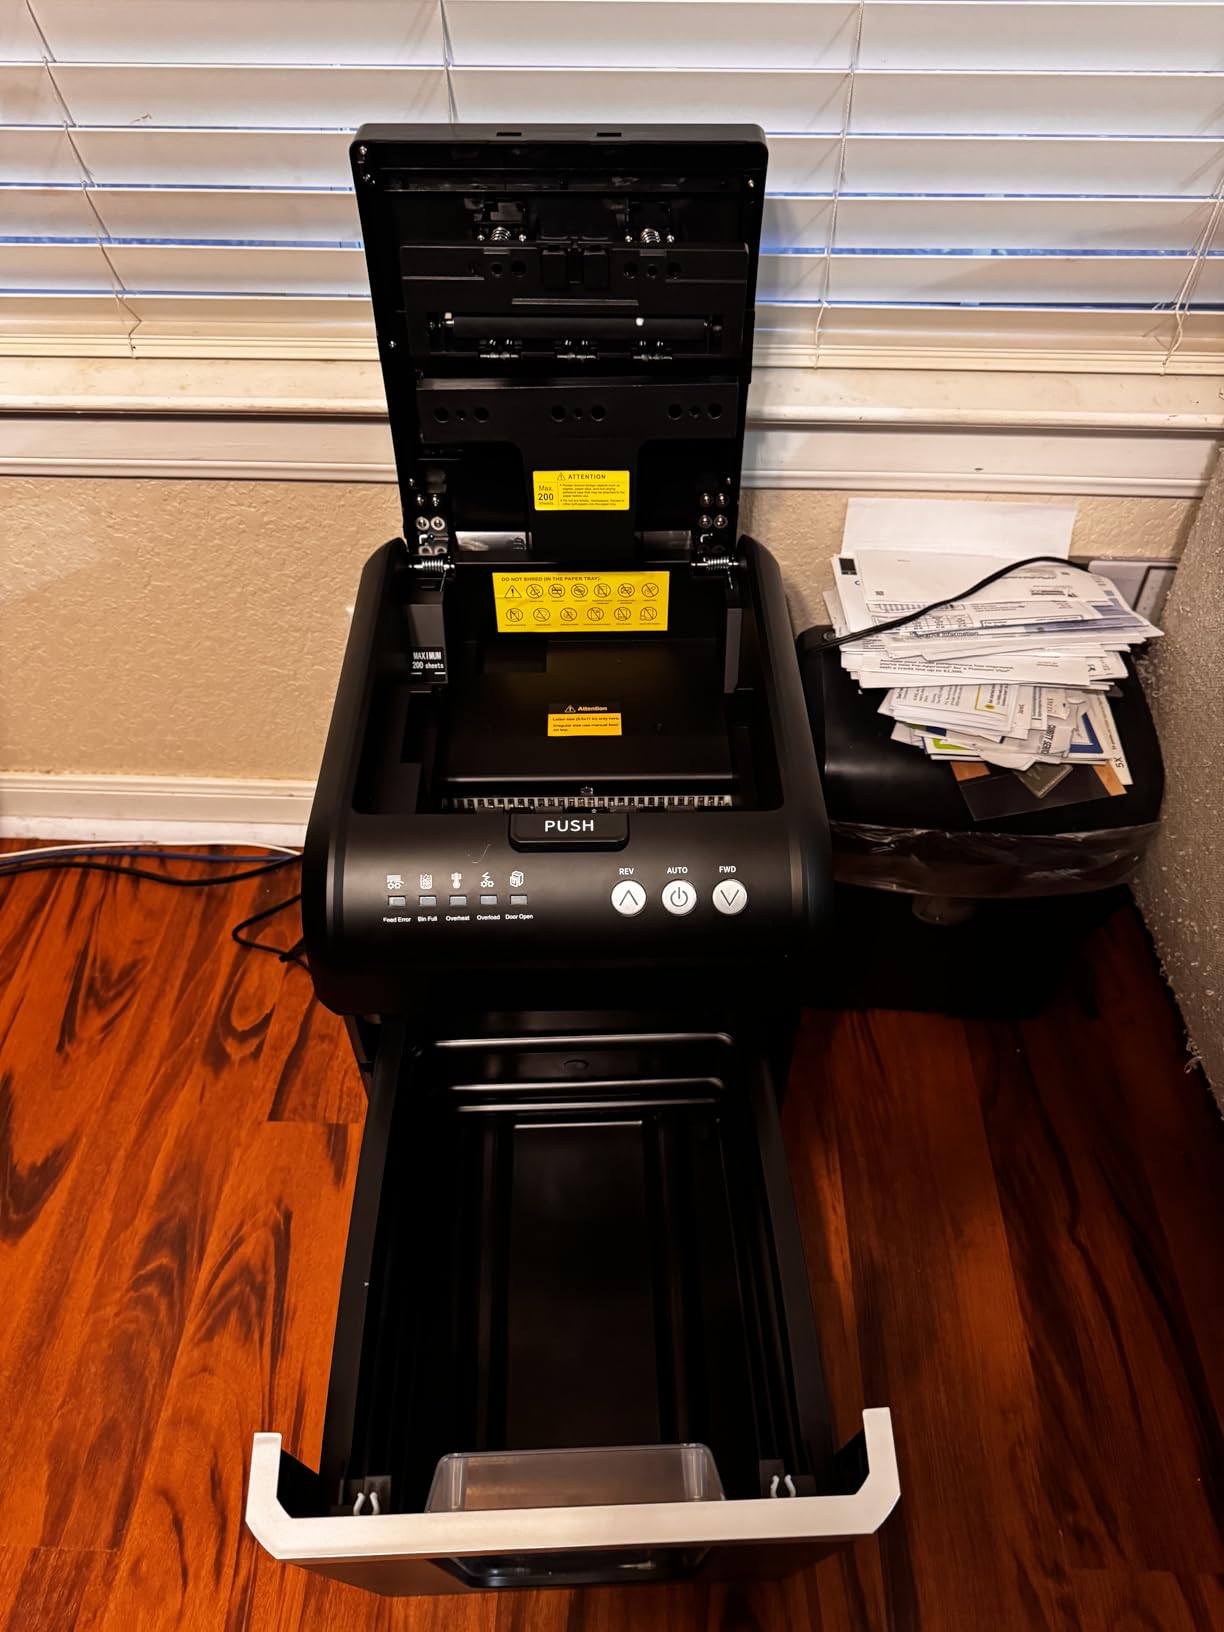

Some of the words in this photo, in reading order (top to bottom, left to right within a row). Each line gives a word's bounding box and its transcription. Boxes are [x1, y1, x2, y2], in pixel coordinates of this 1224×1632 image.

[538, 493, 554, 501] 200
[412, 651, 442, 660] MAXIMUM
[412, 661, 424, 669] 200
[544, 819, 595, 832] PUSH
[619, 867, 635, 876] REV
[666, 866, 689, 875] AUTO
[718, 865, 737, 874] FWD
[518, 913, 534, 921] Open
